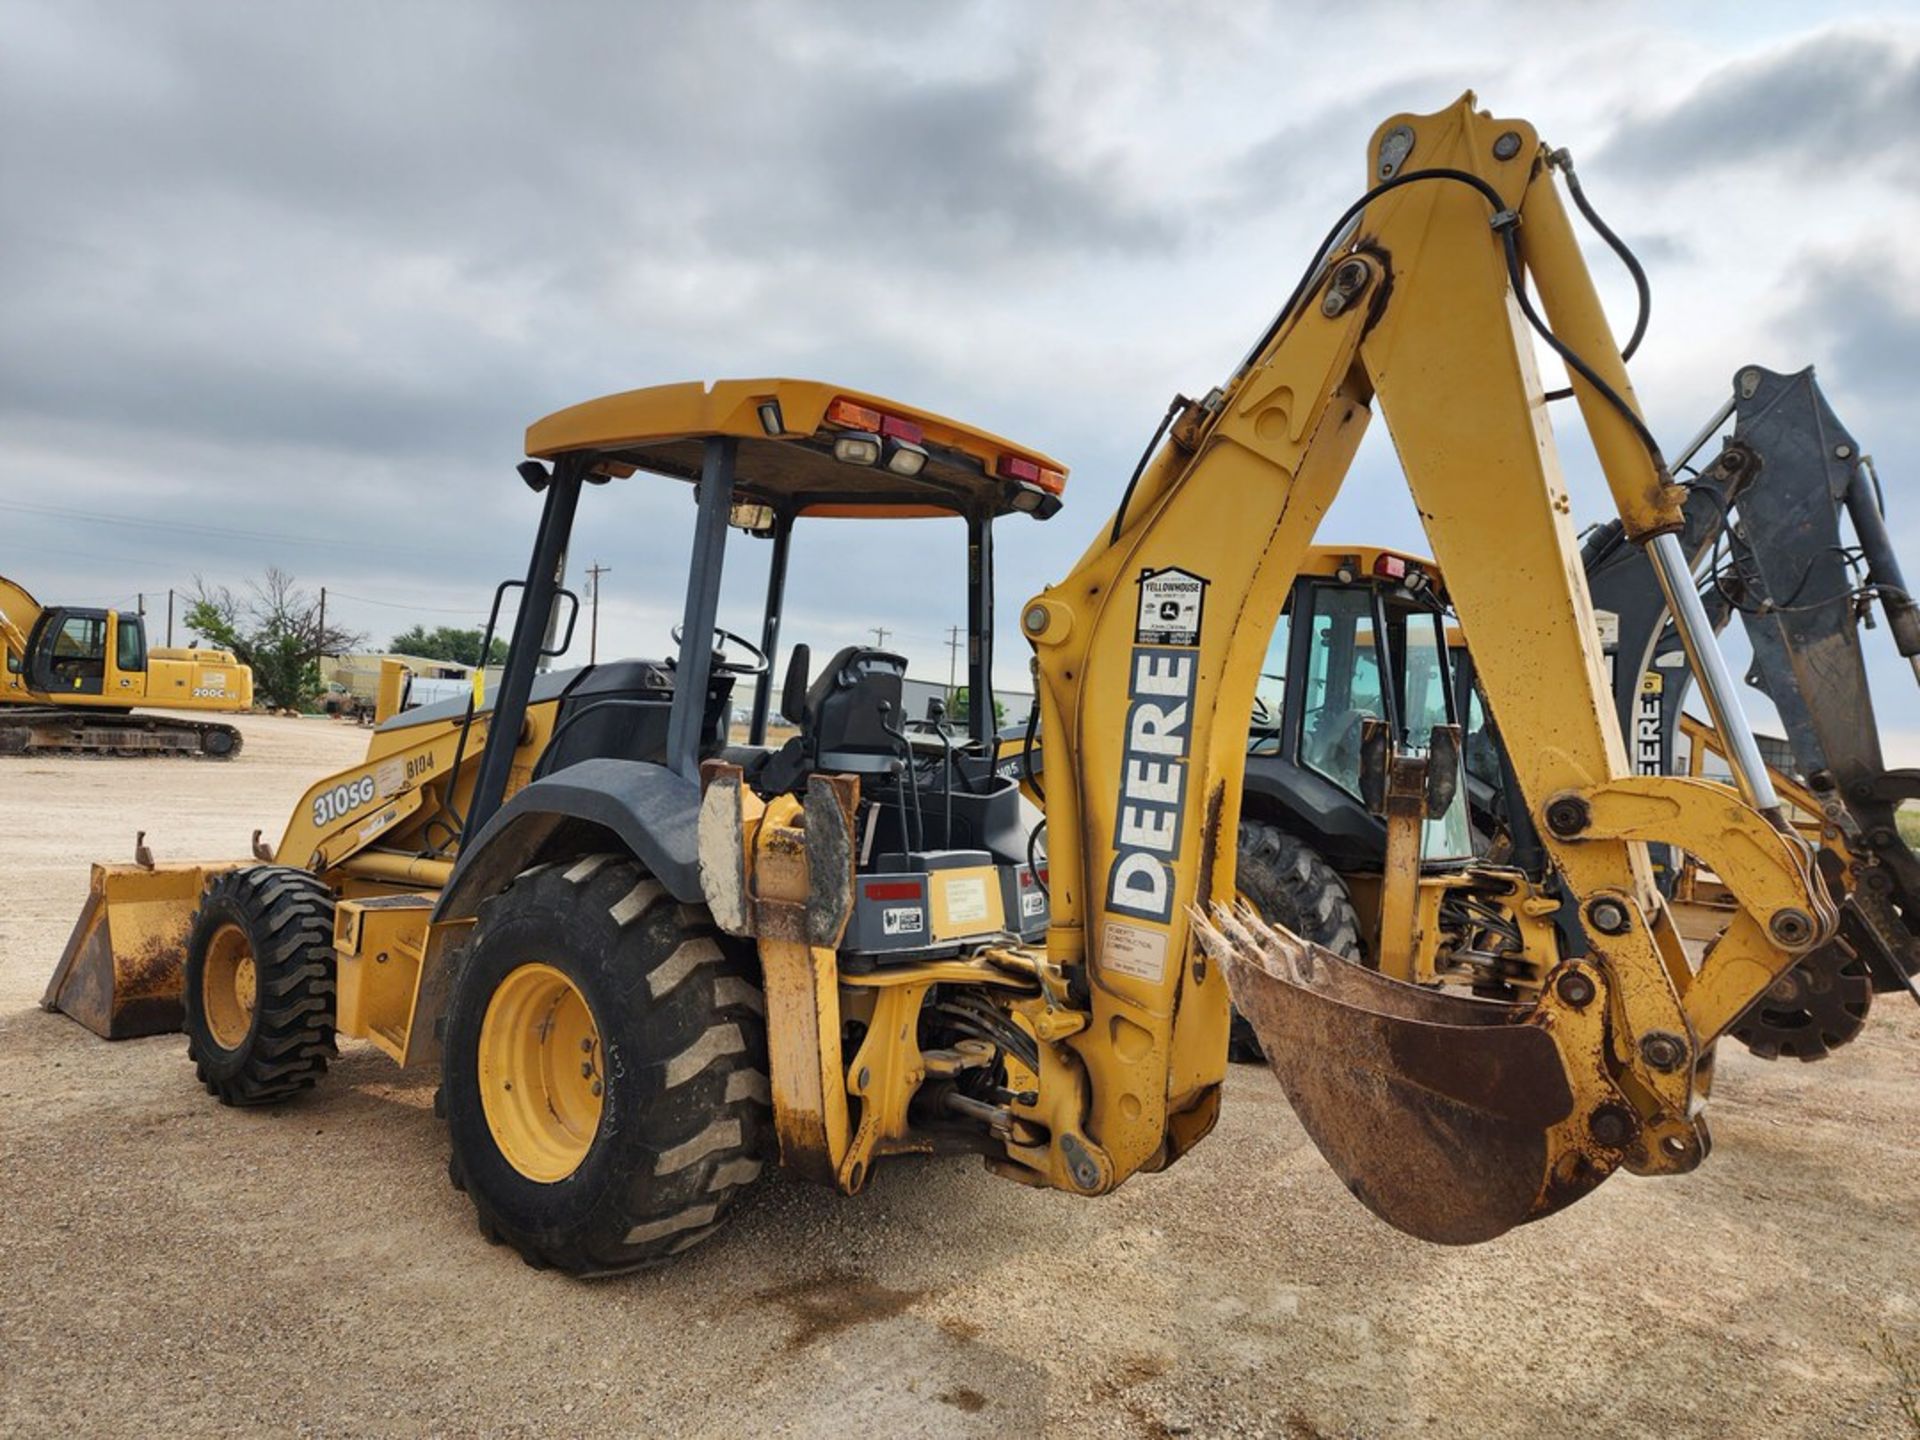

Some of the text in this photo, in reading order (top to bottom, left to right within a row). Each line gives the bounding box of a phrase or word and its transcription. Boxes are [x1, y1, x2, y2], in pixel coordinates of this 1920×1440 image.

[1144, 582, 1200, 593] YELLOWHOUSE
[1637, 699, 1661, 776] EERE
[313, 774, 375, 828] 310SG
[1111, 655, 1192, 915] DEERE
